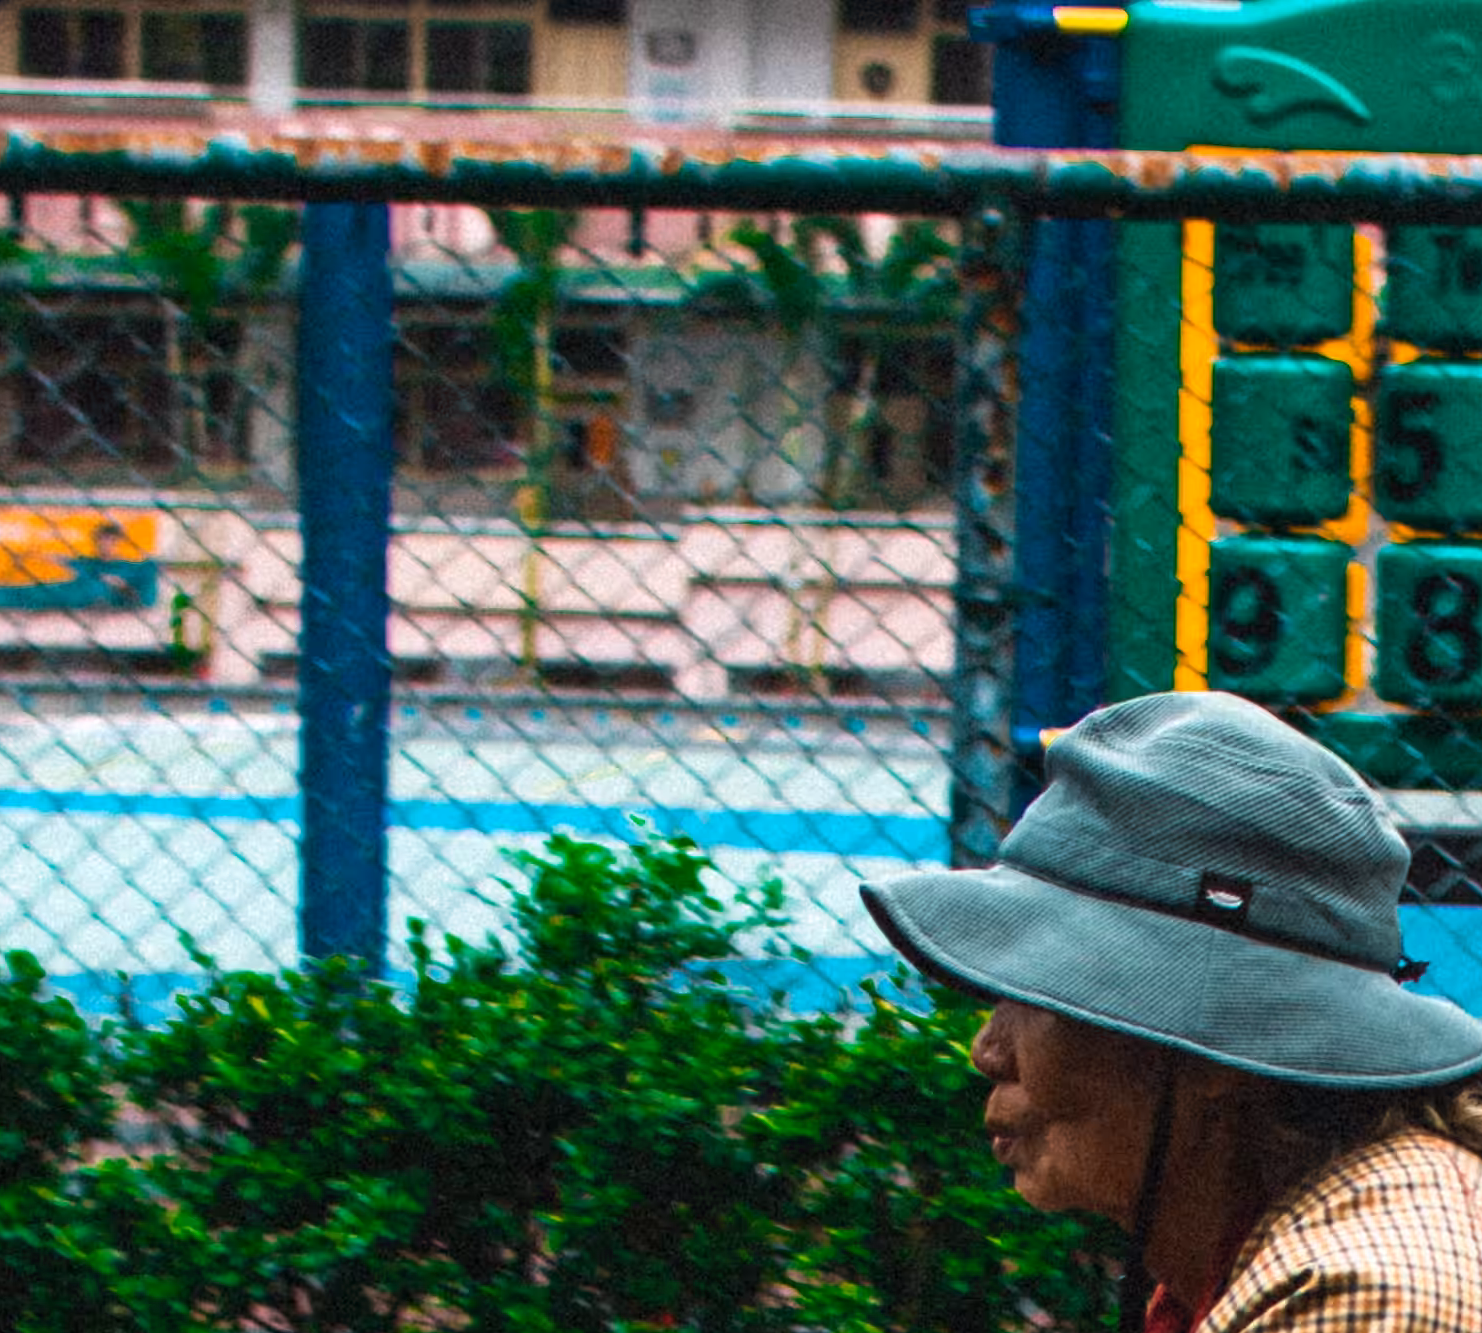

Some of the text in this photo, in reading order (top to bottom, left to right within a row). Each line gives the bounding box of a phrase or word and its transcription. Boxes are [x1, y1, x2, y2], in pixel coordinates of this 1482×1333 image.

[1379, 391, 1445, 502] 5
[1216, 565, 1283, 677] 9
[1405, 570, 1482, 685] 8
